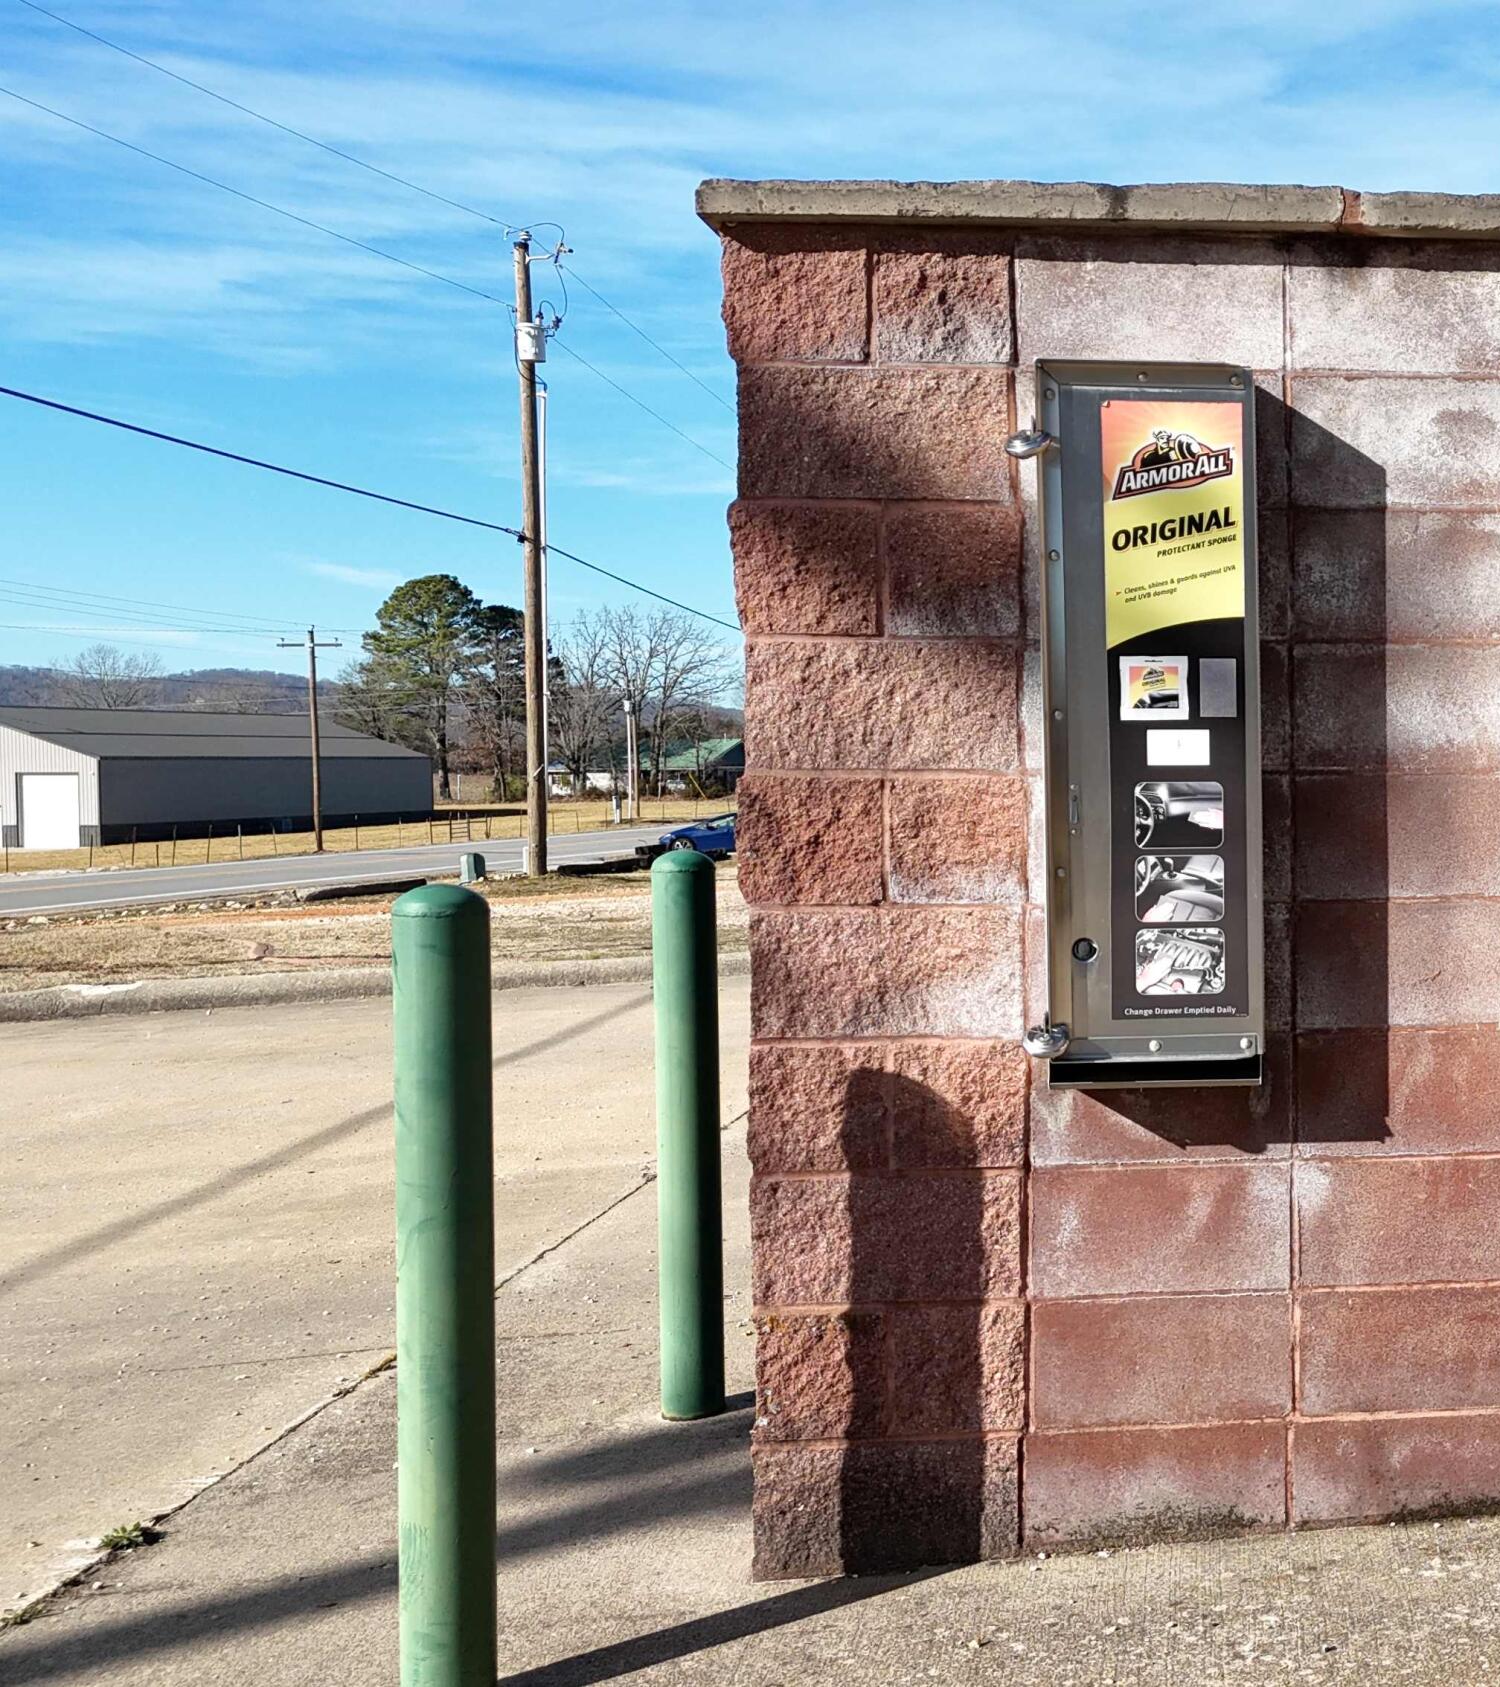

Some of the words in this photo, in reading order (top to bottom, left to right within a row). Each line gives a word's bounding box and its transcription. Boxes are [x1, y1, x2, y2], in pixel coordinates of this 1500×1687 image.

[1112, 506, 1237, 551] ORIGINAL
[1156, 541, 1206, 557] PROTECTANT
[1207, 534, 1237, 547] SPONGE
[1124, 595, 1137, 603] and
[1152, 587, 1178, 597] damage
[1124, 1007, 1154, 1016] Change
[1154, 1007, 1183, 1015] Drawer
[1183, 1006, 1215, 1016] Emptied
[1216, 1006, 1237, 1014] Daily
